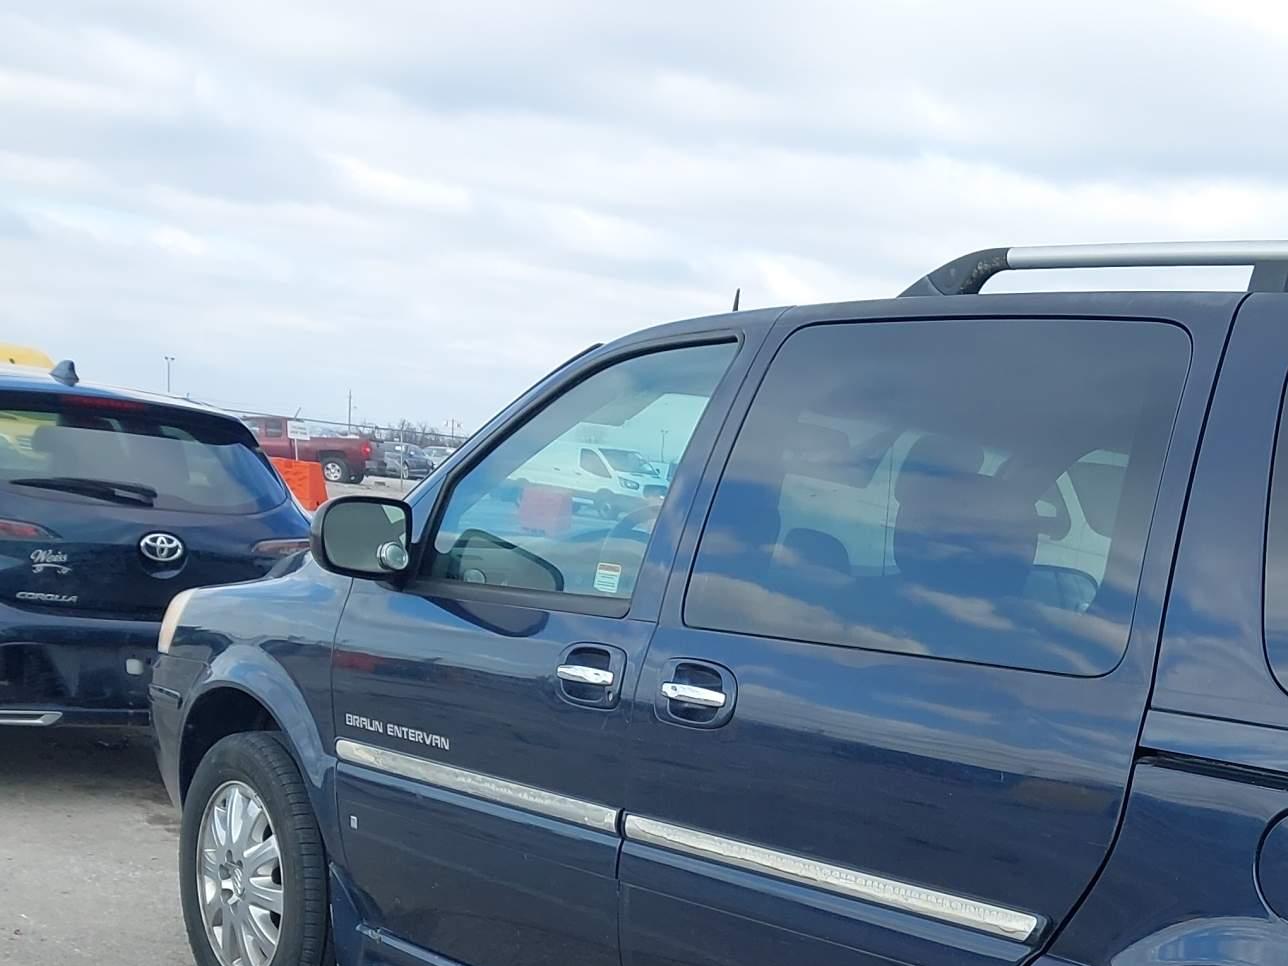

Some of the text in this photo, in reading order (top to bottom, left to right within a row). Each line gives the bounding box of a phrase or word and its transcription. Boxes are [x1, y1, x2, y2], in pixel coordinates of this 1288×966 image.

[15, 591, 78, 602] COROLLA
[345, 713, 450, 750] BRAUN ENTERVAN
